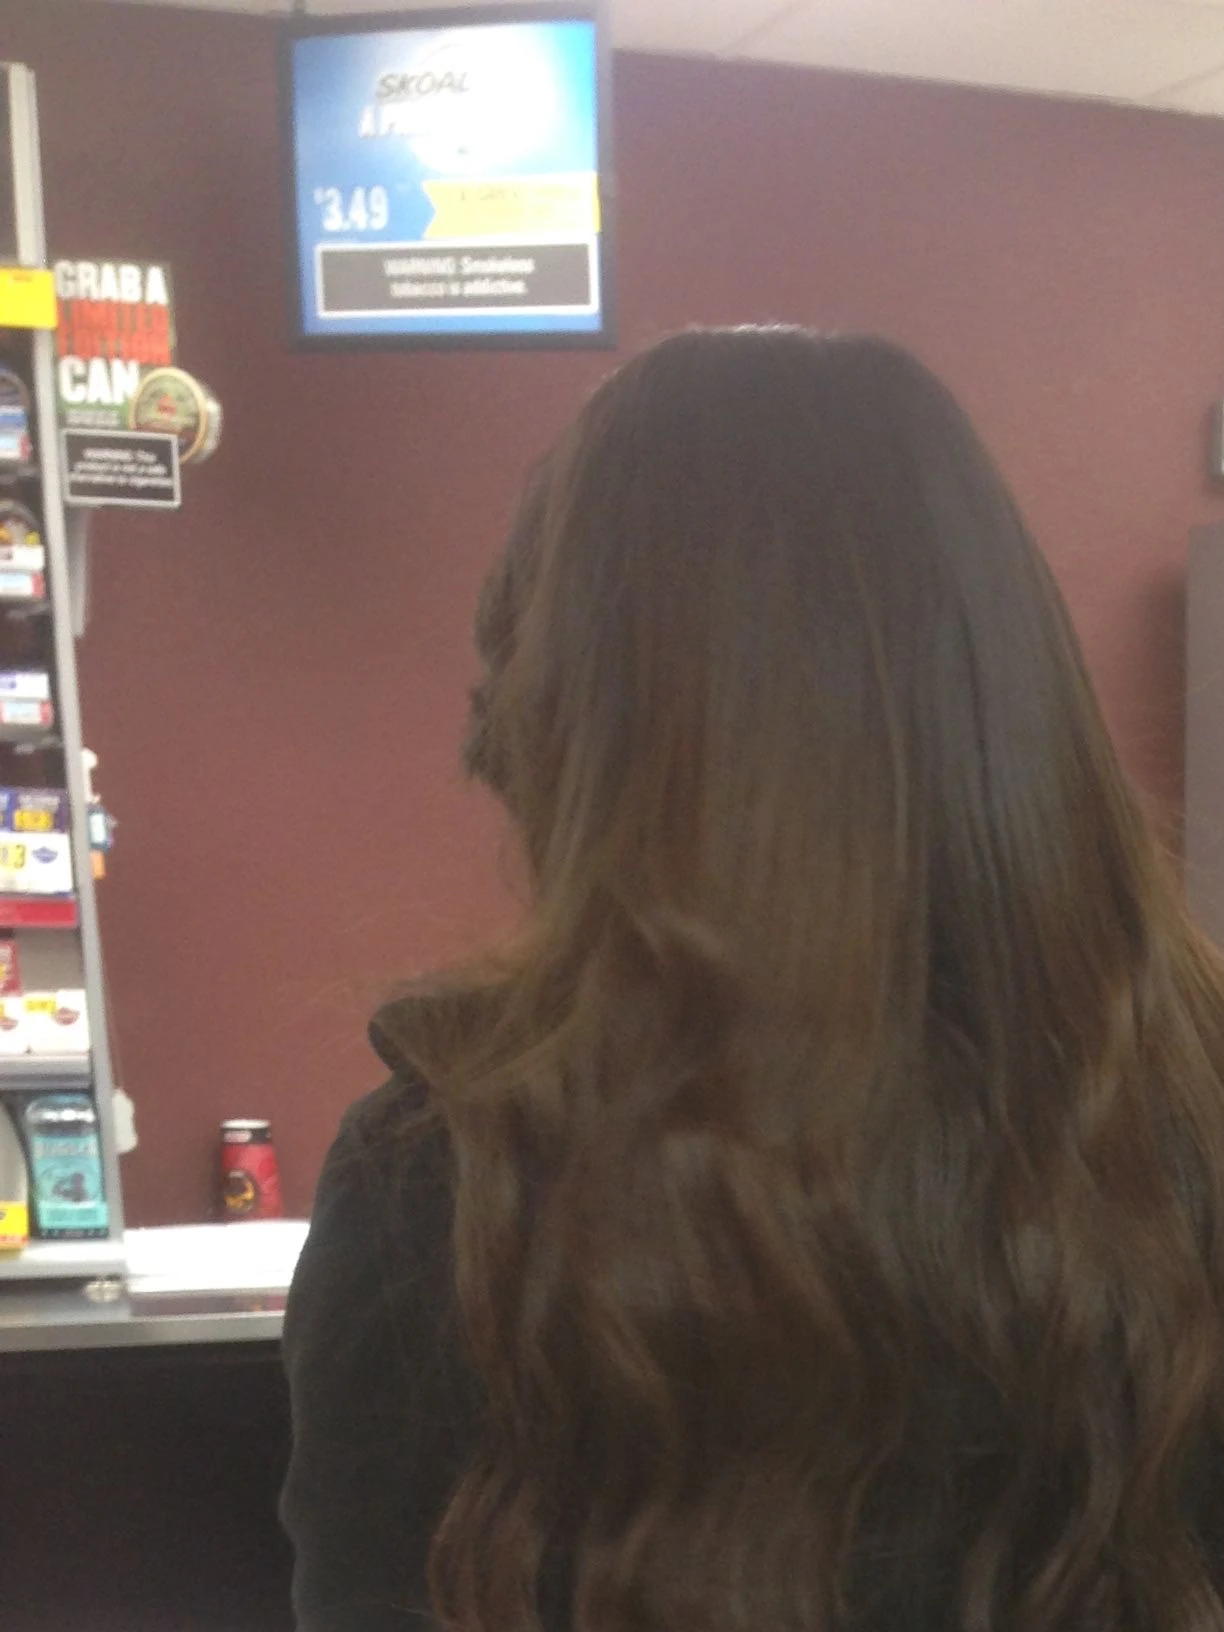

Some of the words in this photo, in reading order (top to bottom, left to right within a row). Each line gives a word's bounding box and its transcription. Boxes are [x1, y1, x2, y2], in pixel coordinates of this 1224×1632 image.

[377, 70, 470, 101] SKOAL
[54, 260, 142, 304] GRAB
[145, 265, 170, 306] A
[58, 354, 141, 406] CAN
